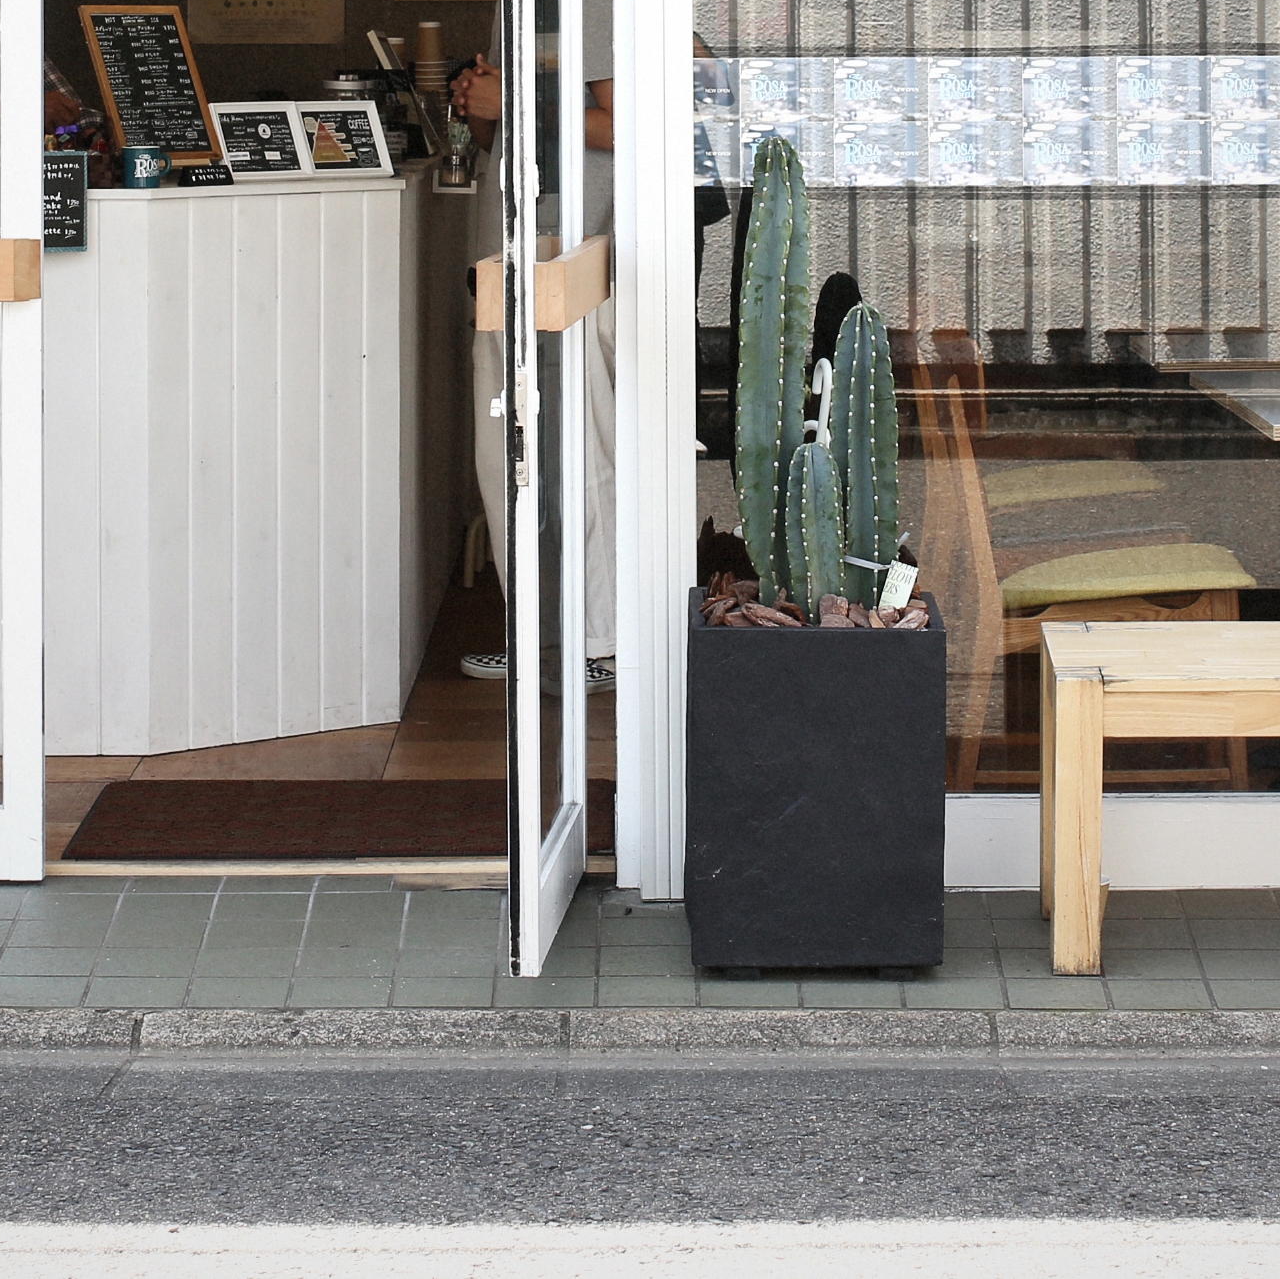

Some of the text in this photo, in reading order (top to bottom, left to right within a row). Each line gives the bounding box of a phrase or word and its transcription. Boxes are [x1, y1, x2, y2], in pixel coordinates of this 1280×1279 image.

[749, 80, 786, 101] ROSA
[843, 79, 880, 100] ROSA
[937, 79, 974, 100] ROSA
[1031, 78, 1068, 100] ROSA
[1126, 78, 1163, 99] ROSA
[1219, 78, 1256, 99] ROSA
[348, 119, 370, 130] COFFEE
[843, 143, 880, 164] ROSA
[938, 142, 975, 164] ROSA
[1032, 142, 1069, 164] ROSA
[1127, 142, 1164, 163] ROSA
[1220, 142, 1258, 163] ROSA
[134, 158, 159, 178] ROS
